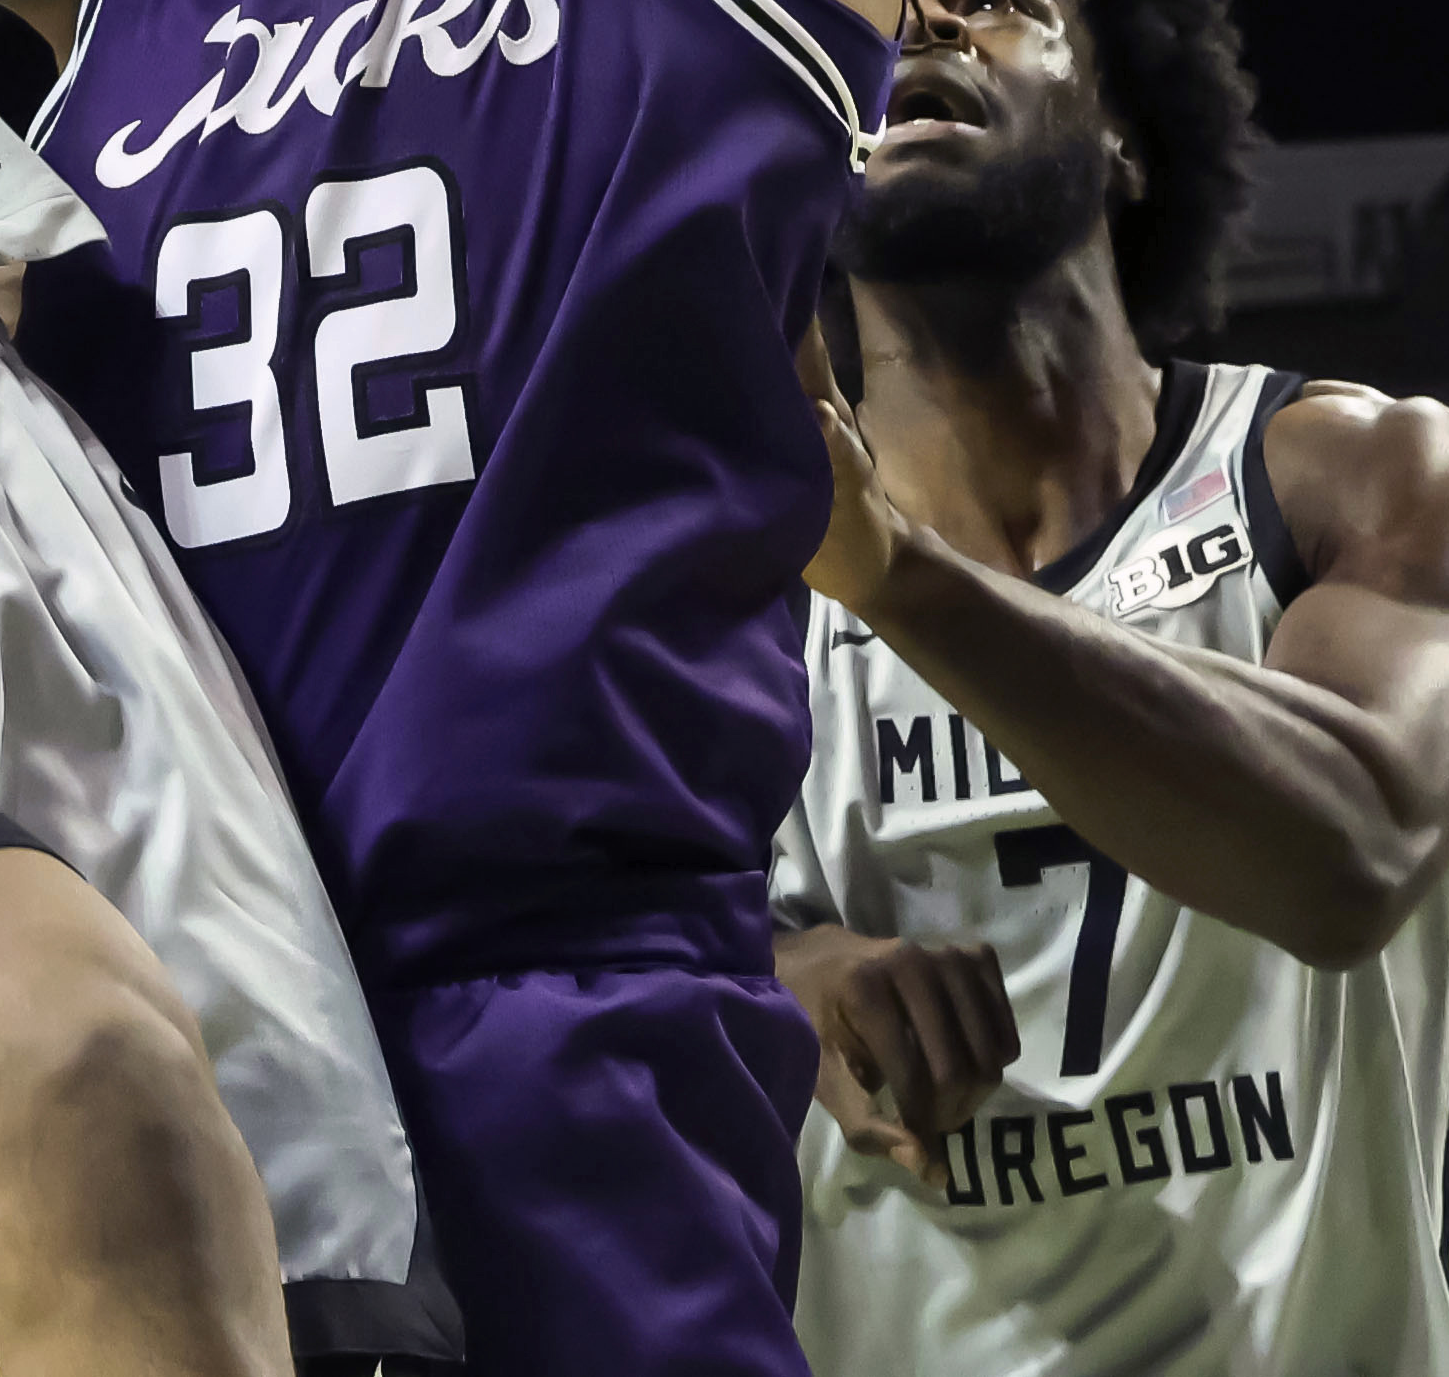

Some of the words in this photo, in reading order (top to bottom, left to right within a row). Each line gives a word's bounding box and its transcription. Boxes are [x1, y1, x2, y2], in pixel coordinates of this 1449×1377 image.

[153, 164, 477, 550] 32
[994, 825, 1135, 1079] 7
[944, 1070, 1297, 1208] OREGON
